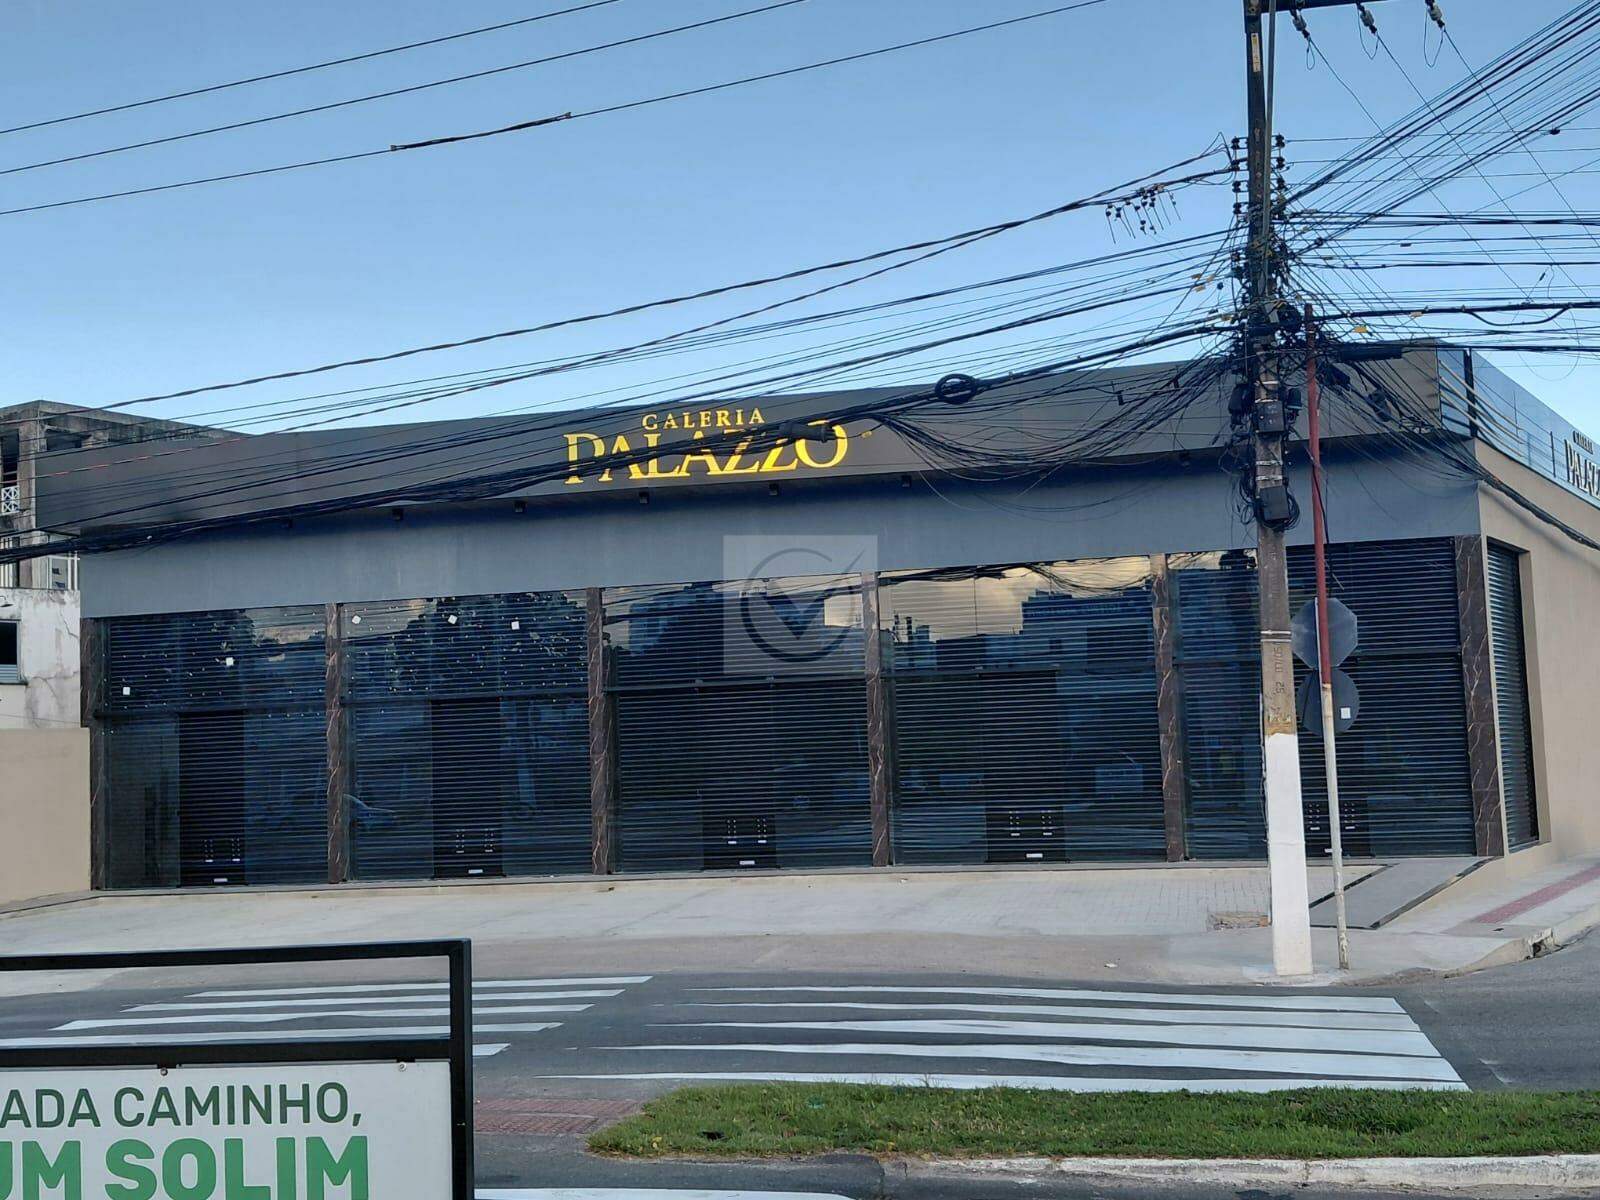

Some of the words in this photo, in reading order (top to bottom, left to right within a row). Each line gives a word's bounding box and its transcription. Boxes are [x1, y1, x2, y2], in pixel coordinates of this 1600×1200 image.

[642, 407, 765, 430] GALERIA
[0, 1088, 101, 1128] ADA
[113, 1082, 362, 1128] CAMINHO,
[0, 1140, 81, 1200] M
[104, 1135, 369, 1200] SOLIM
